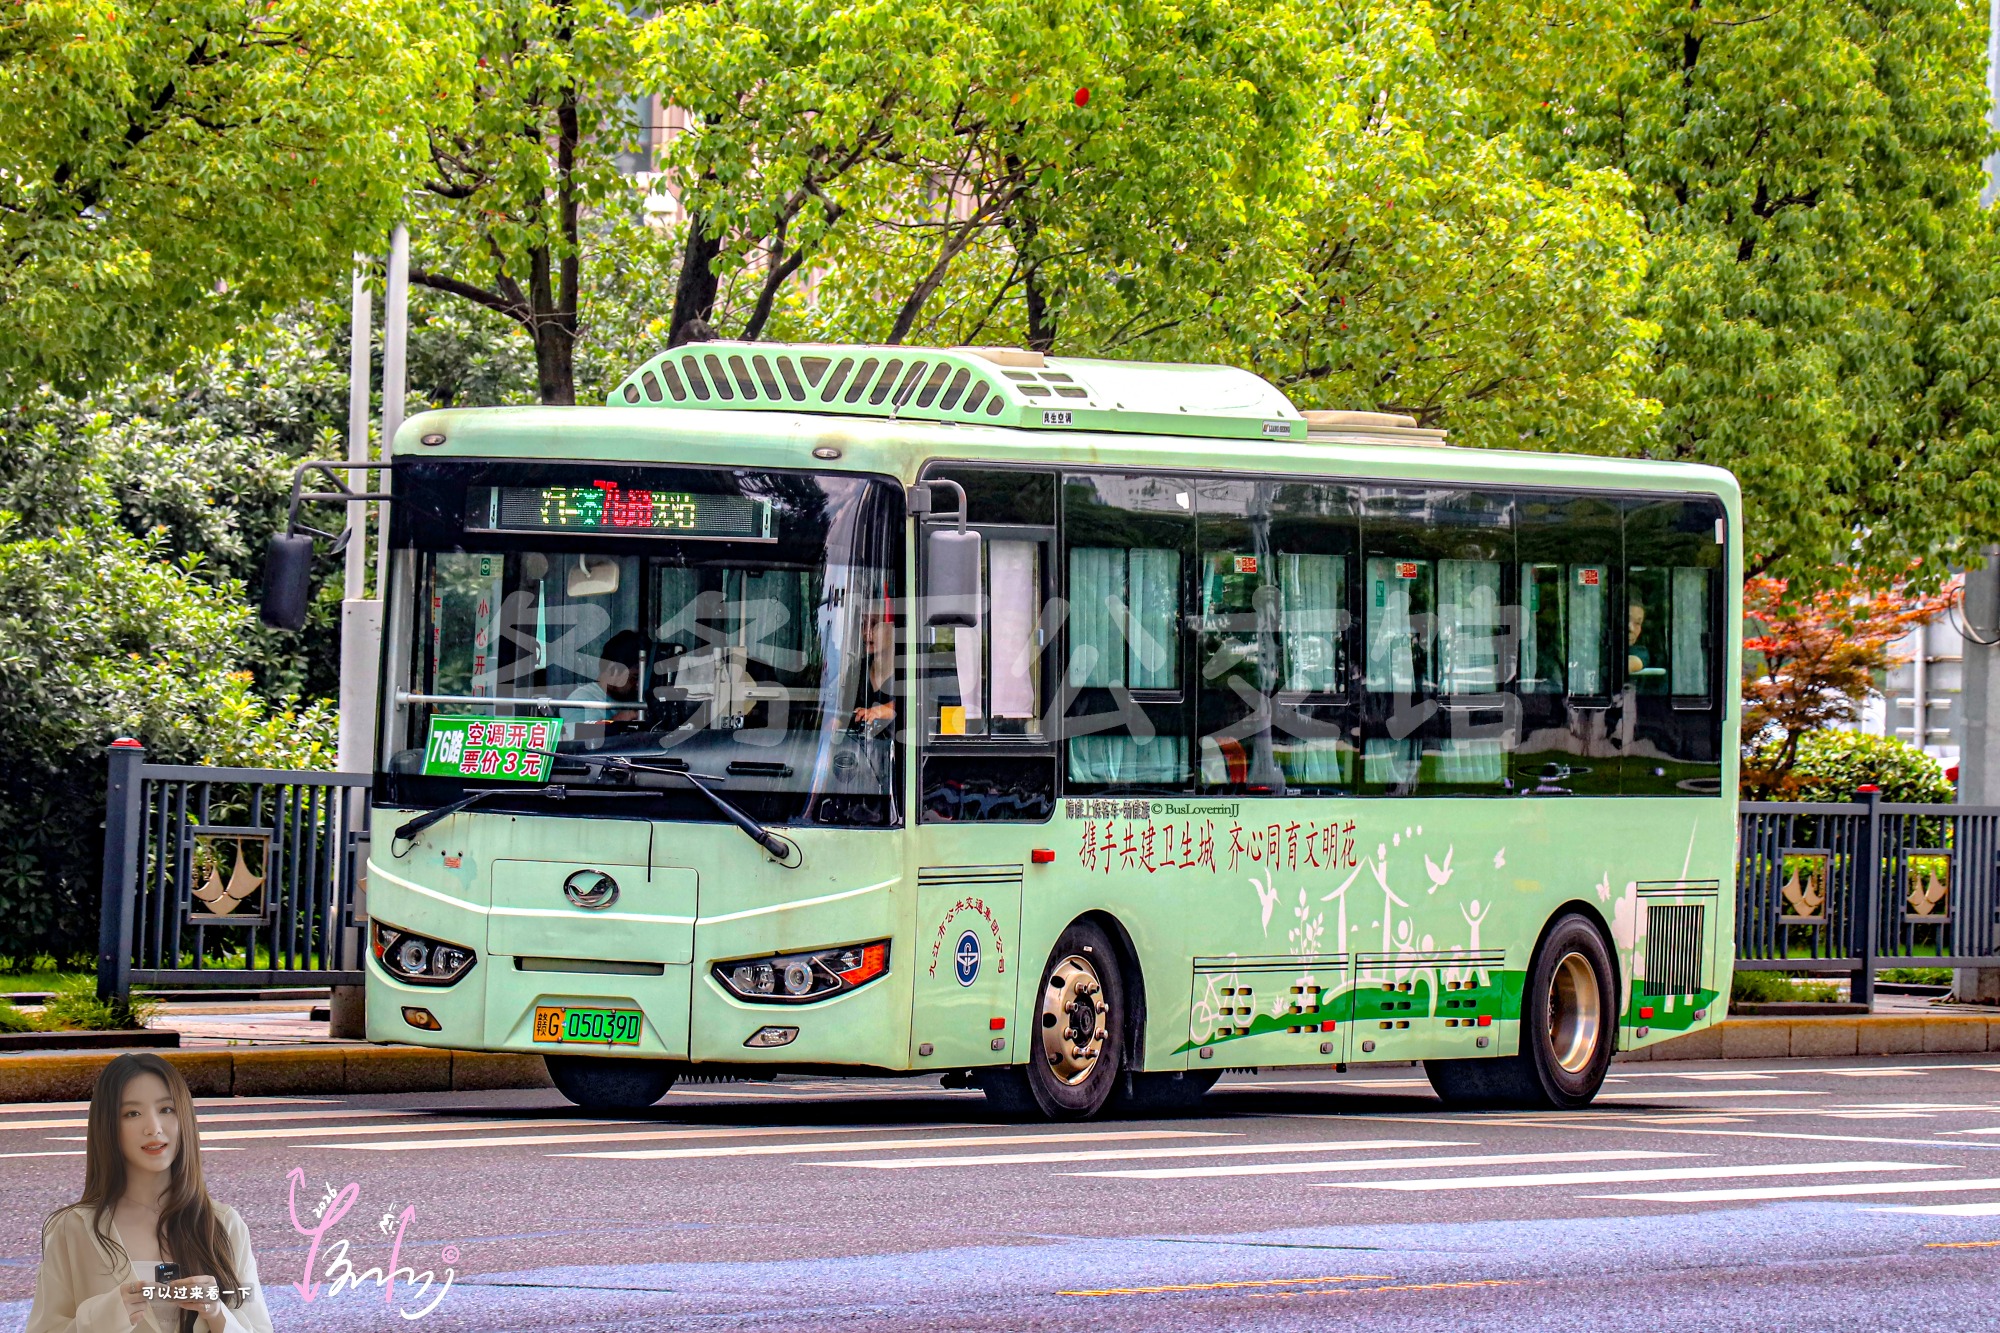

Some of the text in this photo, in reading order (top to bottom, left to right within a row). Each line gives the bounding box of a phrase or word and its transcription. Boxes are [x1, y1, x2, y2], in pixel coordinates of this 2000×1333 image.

[431, 730, 464, 764] 76路
[466, 722, 548, 750] 空调开启
[1078, 819, 1358, 875] 携手共建卫生城 齐心同育文明花
